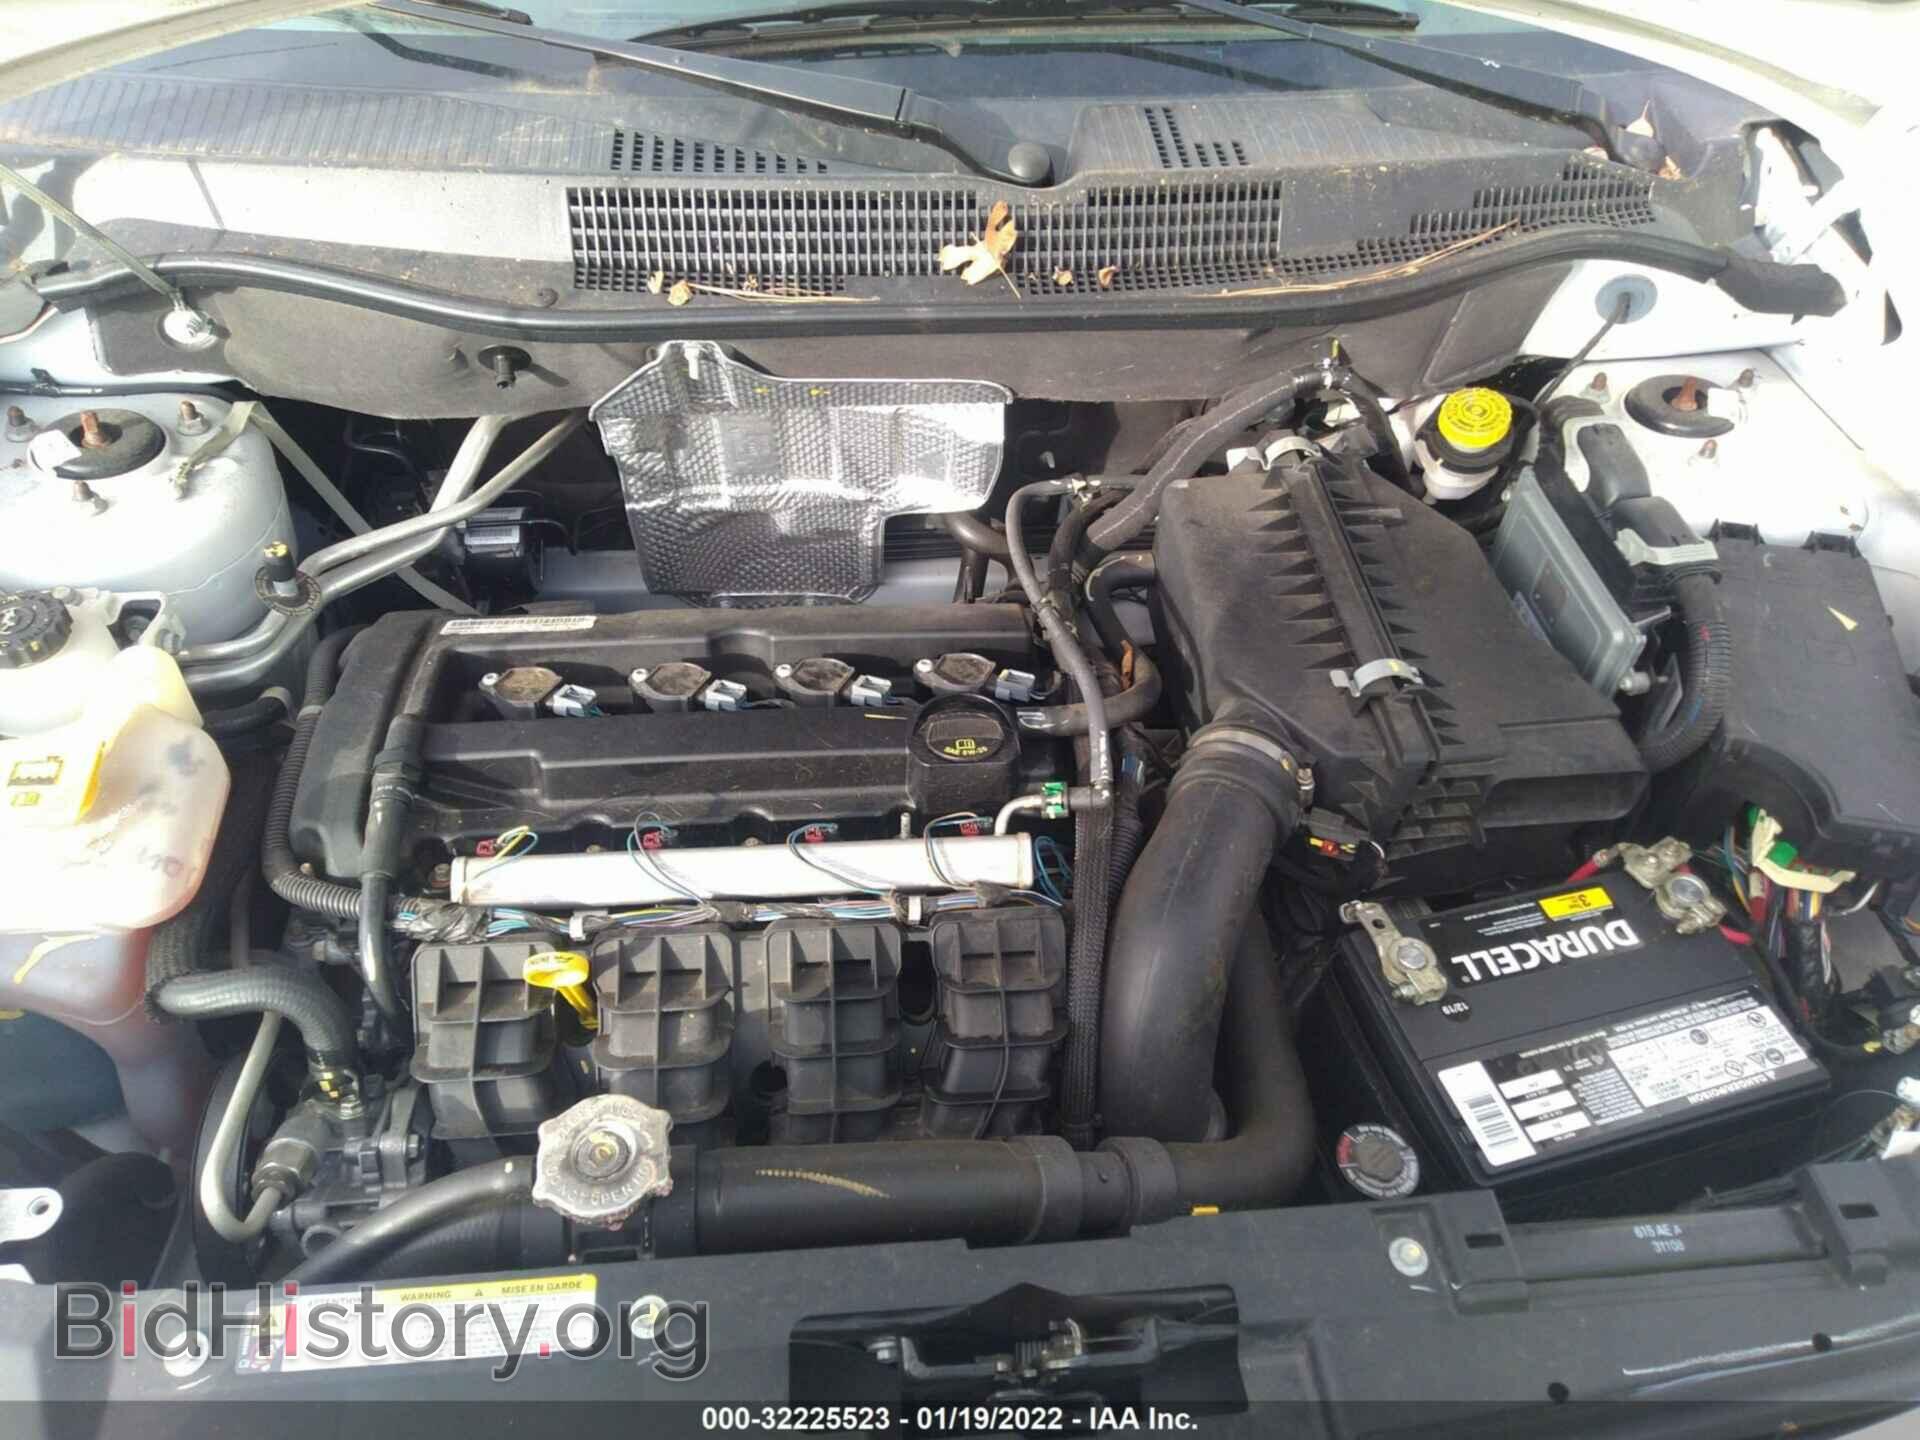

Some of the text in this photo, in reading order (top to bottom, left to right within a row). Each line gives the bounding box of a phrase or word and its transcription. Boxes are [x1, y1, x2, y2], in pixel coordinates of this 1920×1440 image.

[1451, 918, 1640, 981] DURACELL
[401, 1289, 451, 1301] WARNING
[502, 1281, 582, 1295] MISE EN GARDE
